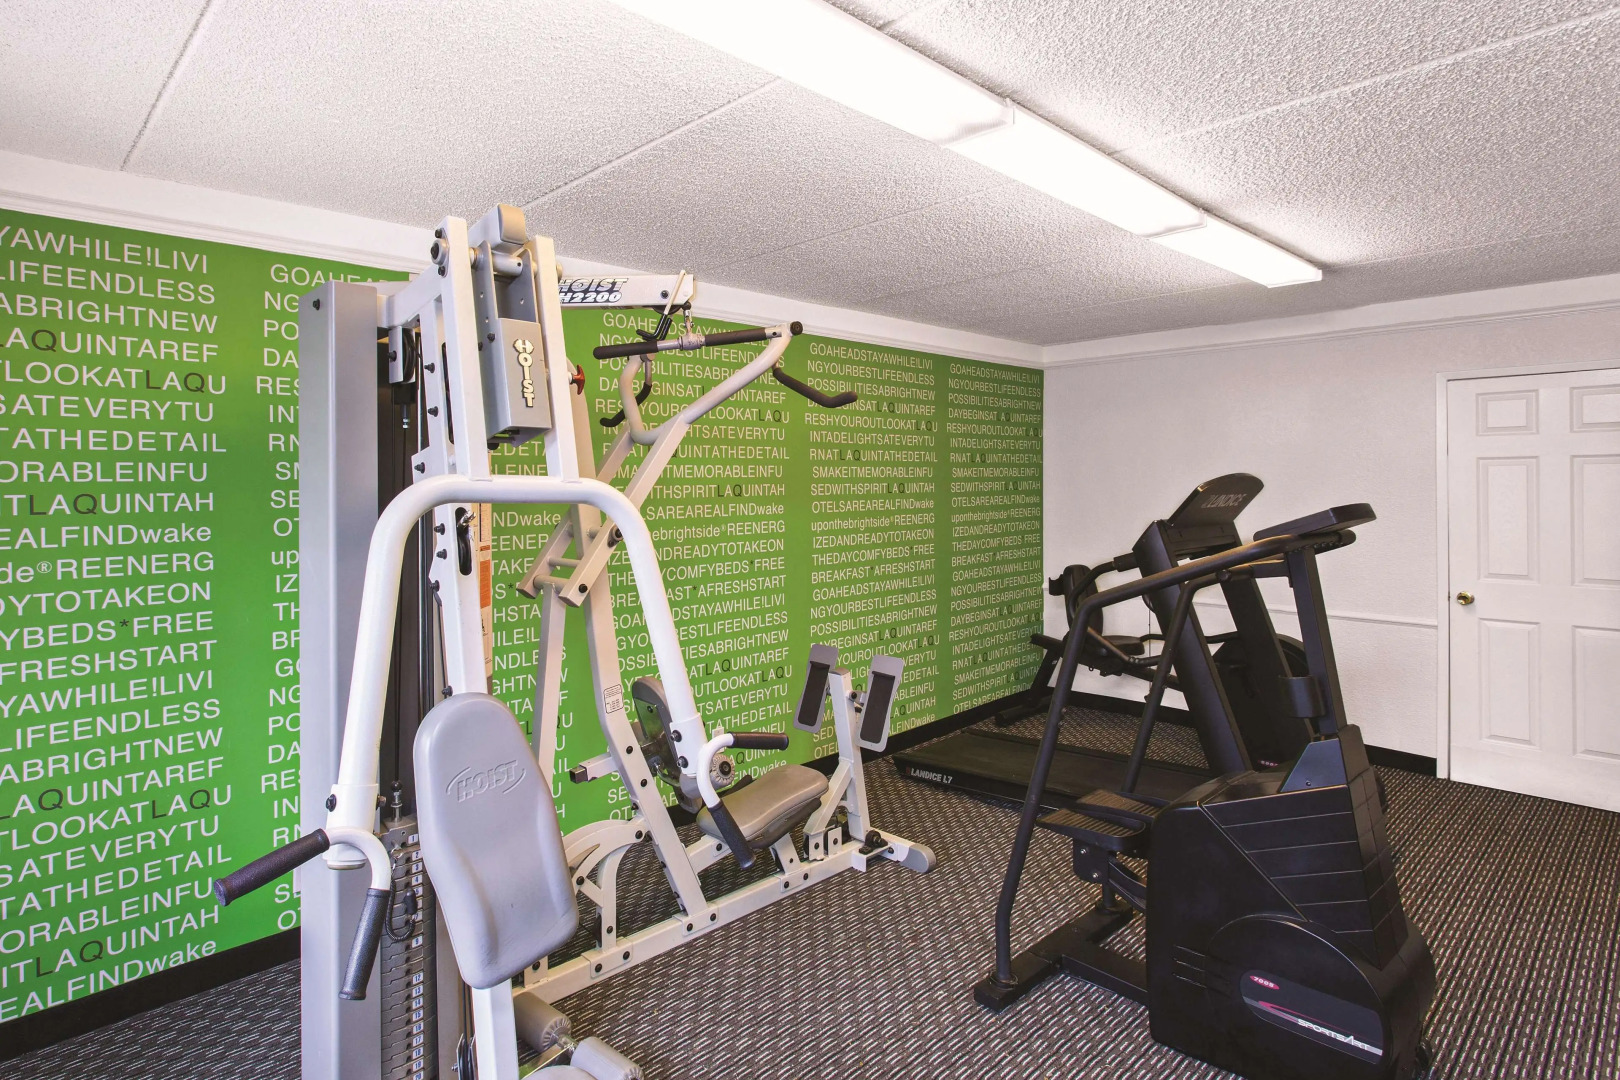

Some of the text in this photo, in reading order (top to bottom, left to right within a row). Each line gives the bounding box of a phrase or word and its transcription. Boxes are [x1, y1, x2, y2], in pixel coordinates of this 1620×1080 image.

[0, 260, 215, 304] IFEENDLESS
[558, 277, 628, 292] HOIST
[559, 291, 622, 304] H2200
[0, 327, 218, 362] AQUINTAREF
[809, 342, 933, 370] GOAHEADSTAYAWHILE!LIVI
[0, 359, 226, 394] LOOKATLAQU
[513, 339, 534, 407] HOIST
[807, 360, 935, 386] NGYOURBESTLIFEENDLESS
[948, 378, 1041, 398] NGYOURBESTLIFEENDLESS
[948, 393, 1041, 411] POSSIBILITIESABRIGHTNEW
[805, 412, 938, 433] RESHYOUROUTLOOKATLAQU
[809, 430, 935, 447] INTADELIGHTSATEVERYTU
[950, 437, 1040, 450] INTADELIGHTSATEVERYTU
[809, 448, 938, 462] RNATLAQUINTATHEDETAIL
[812, 466, 933, 478] SMAKEITMEMORABLEINFU
[952, 467, 1040, 478] SMAKEITMEMORABLEINFU
[811, 482, 935, 496] SEDWITHSPIRITLAQUINTAH
[950, 481, 1041, 493] SEDWITHSPIRITLAQUINTAH
[811, 498, 934, 514] OTELSAREAREALFINDwake
[951, 495, 1040, 507] OTELSAREAREALFINDwake
[812, 529, 935, 549] IZEDANDREADYTOTAKEON
[952, 521, 1040, 537] IZEDANDREADYTOTAKEON
[812, 574, 935, 602] GOAHEADSTAYAWHILE!LIVI
[951, 572, 1042, 597] NGYOURBESTLIFEENDLESS
[0, 581, 211, 617] YTOTAKEON
[810, 589, 937, 619] NGYOURBESTLIFEENDLESS
[951, 587, 1042, 611] POSSIBILITIESABRIGHTNEW
[810, 604, 938, 637] POSSIBILITIESABRIGHTNEW
[0, 640, 217, 685] FRESHSTART
[0, 728, 224, 786] ABRIGHTNEW
[457, 759, 519, 803] HOIST
[911, 767, 942, 782] LANDICE
[0, 878, 212, 954] ORABLEINFU
[3, 906, 219, 988] ITLAQUINTAH
